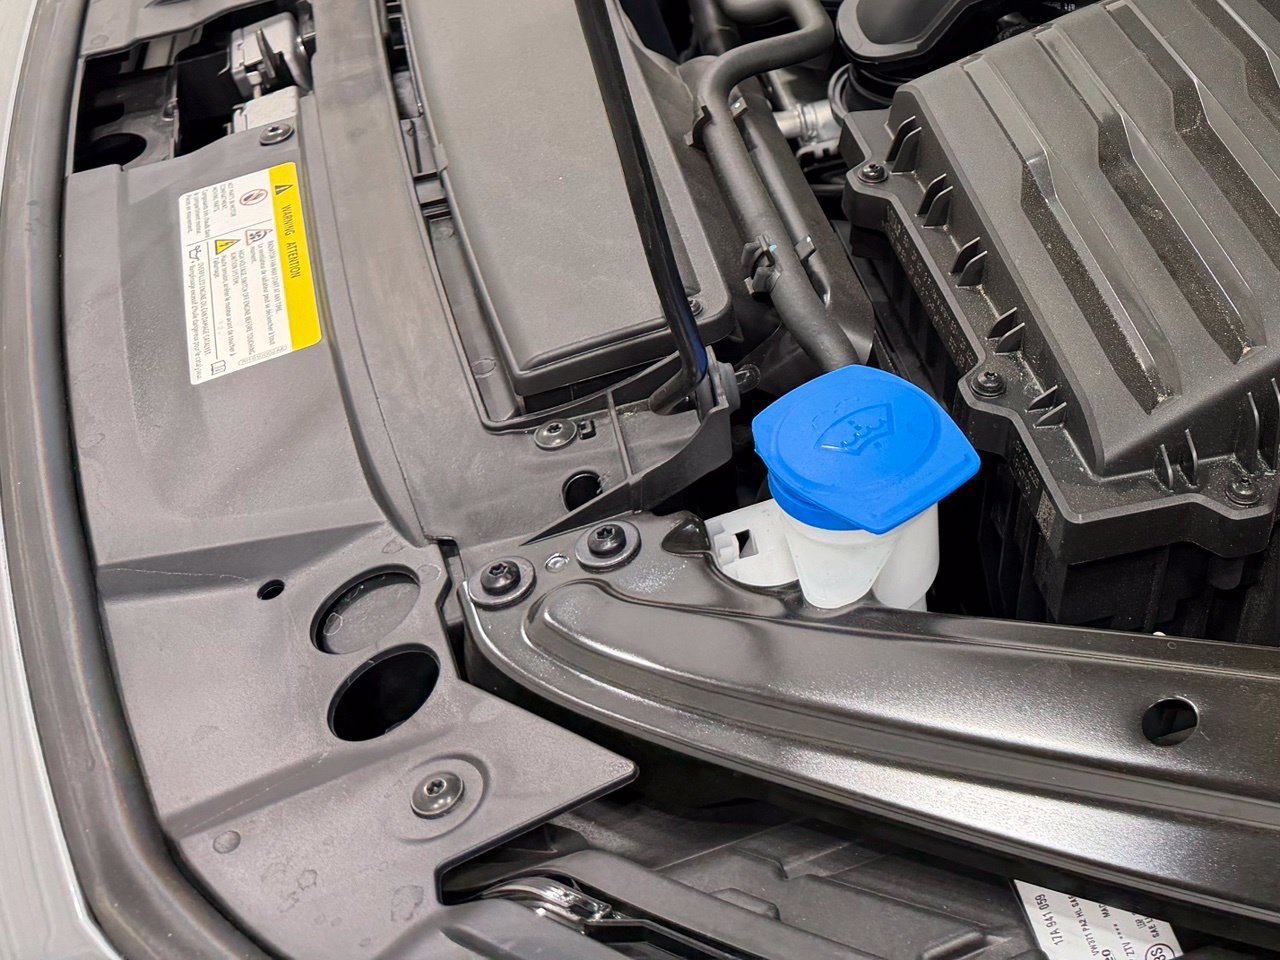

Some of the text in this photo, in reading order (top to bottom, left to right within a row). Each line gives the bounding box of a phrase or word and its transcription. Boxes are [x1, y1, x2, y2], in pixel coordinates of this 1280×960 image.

[281, 204, 301, 279] WARNING ATTENTION
[1035, 894, 1064, 945] 17A 941 059
